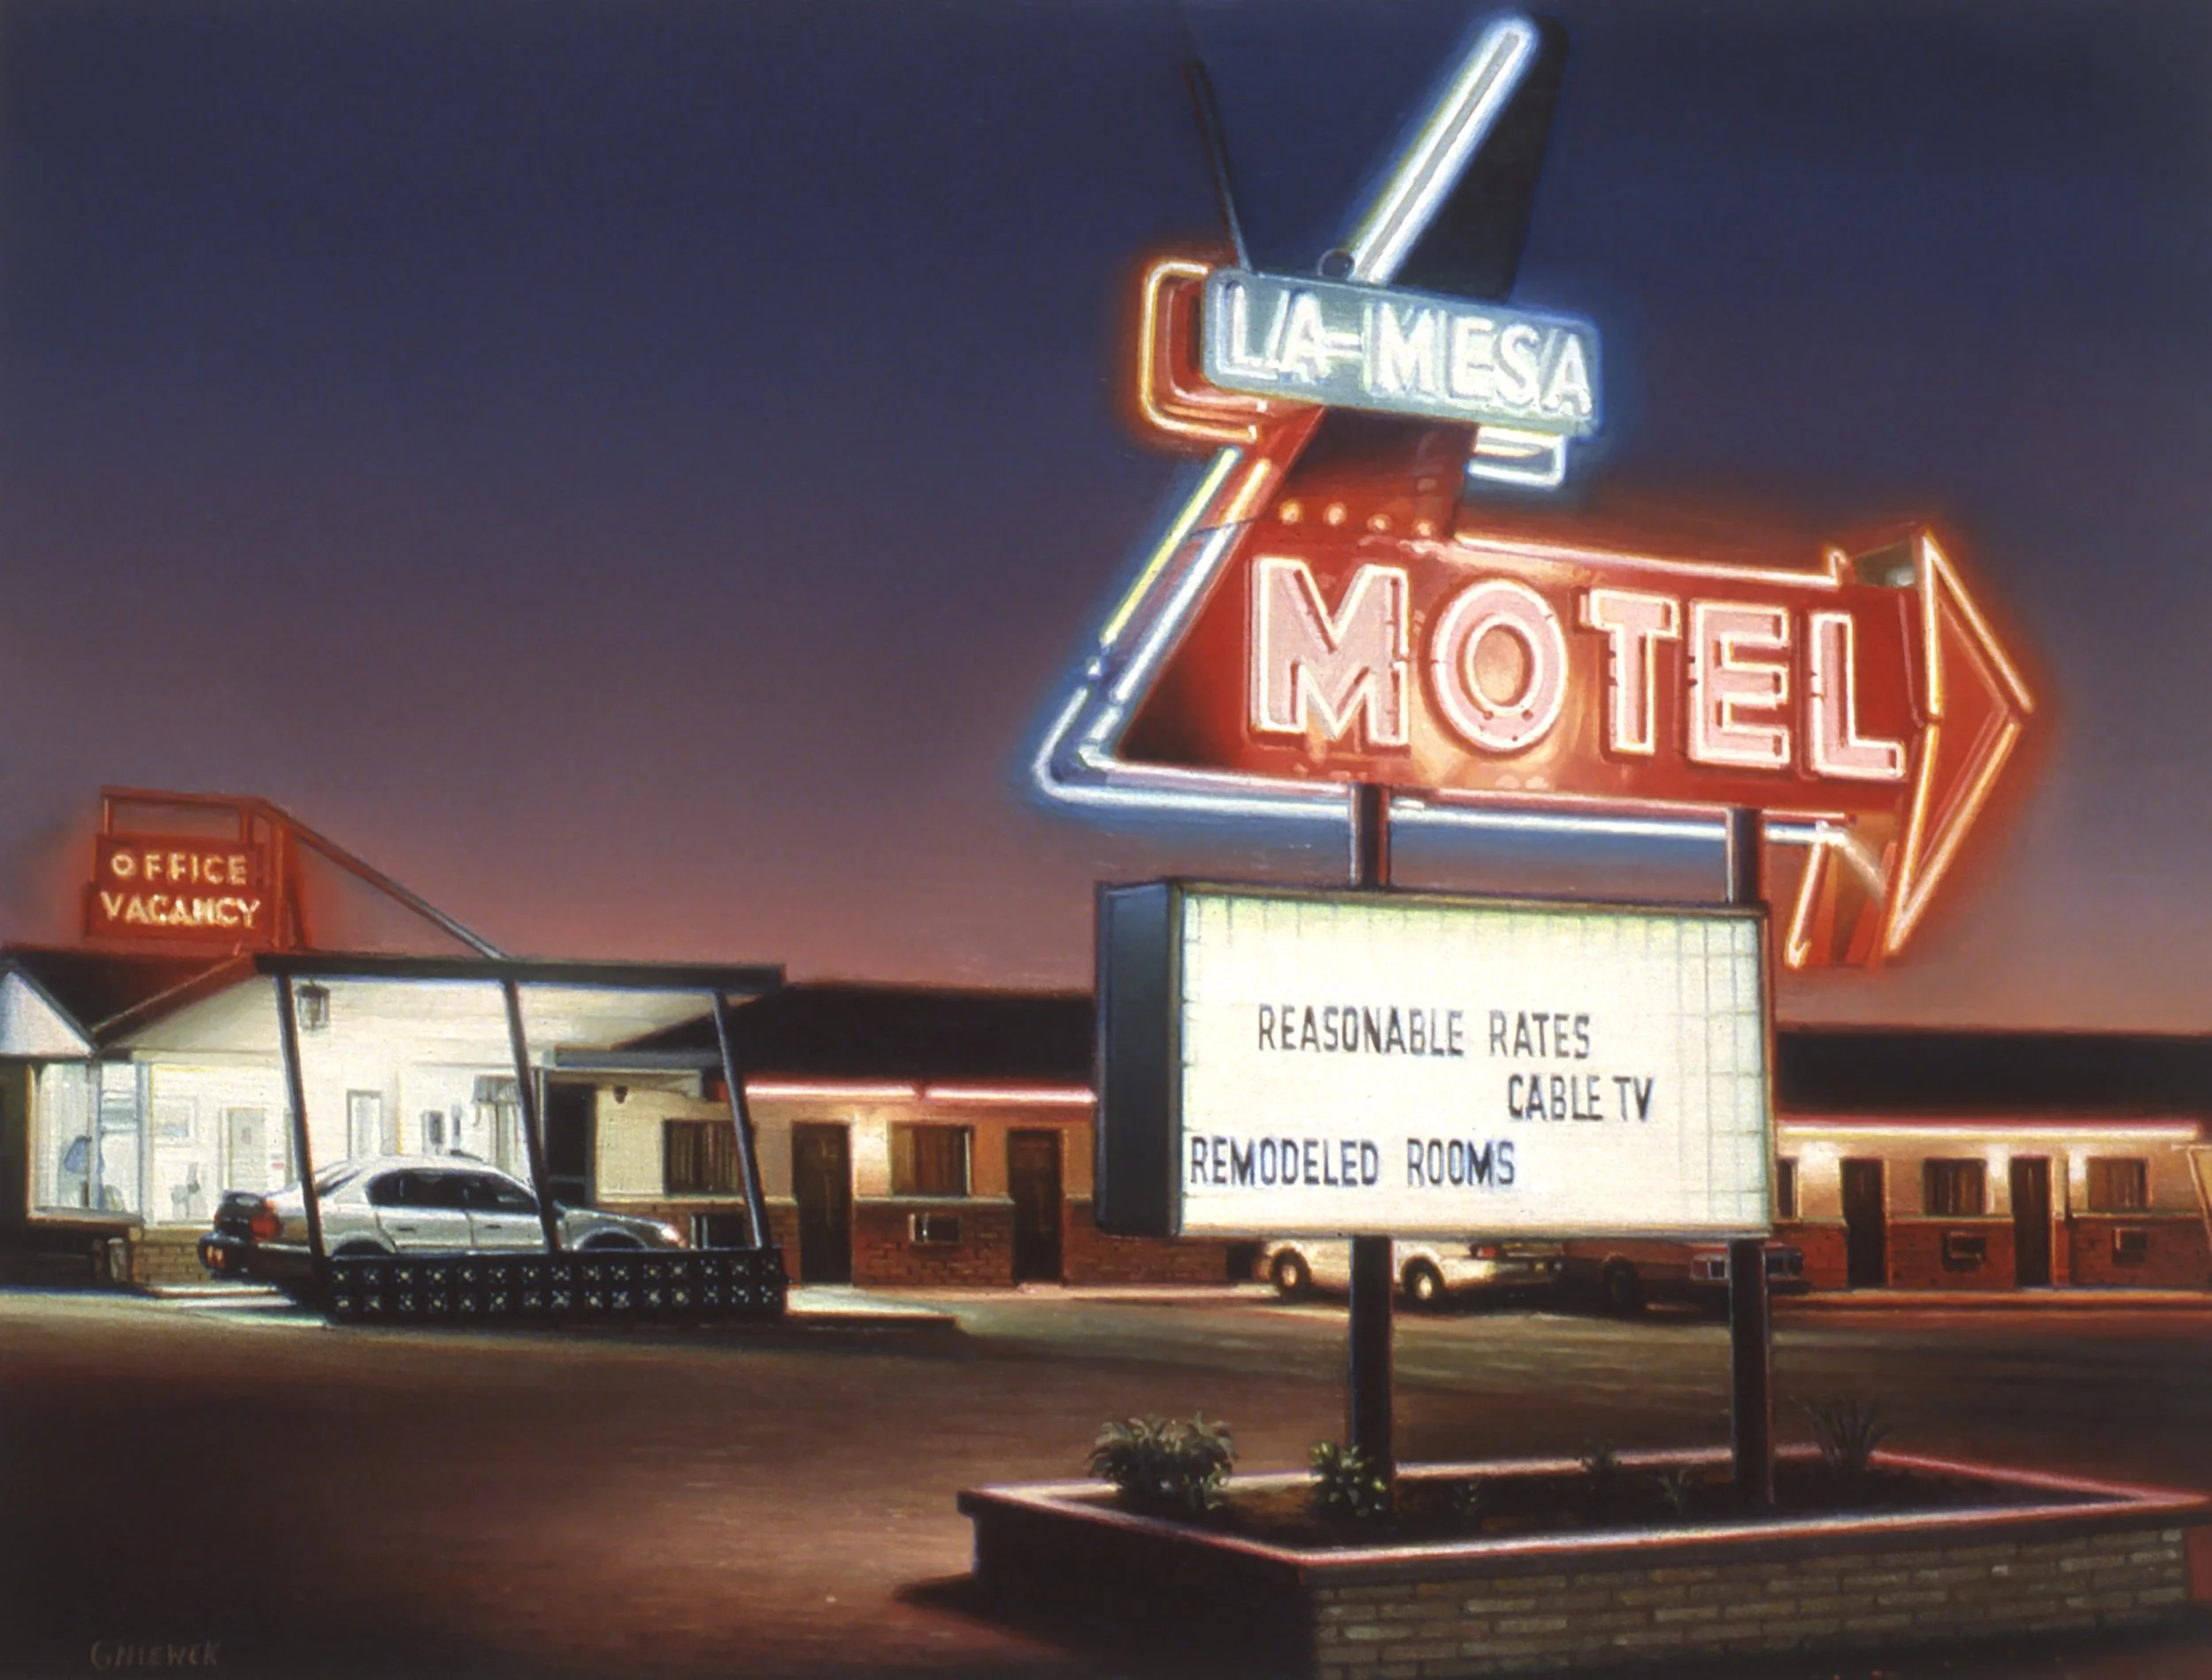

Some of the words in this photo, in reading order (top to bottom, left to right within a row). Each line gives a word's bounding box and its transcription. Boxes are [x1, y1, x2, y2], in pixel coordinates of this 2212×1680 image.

[1250, 556, 1906, 779] MOTEL
[111, 852, 246, 885] OFFICE
[99, 890, 261, 928] VACANCY
[1258, 1004, 1464, 1057] REASONABLE
[1489, 1010, 1591, 1060] RATES
[1508, 1074, 1603, 1122] CABLE
[1613, 1076, 1653, 1123] TV
[1190, 1136, 1379, 1186] REMODELED
[1407, 1138, 1516, 1186] ROOMS
